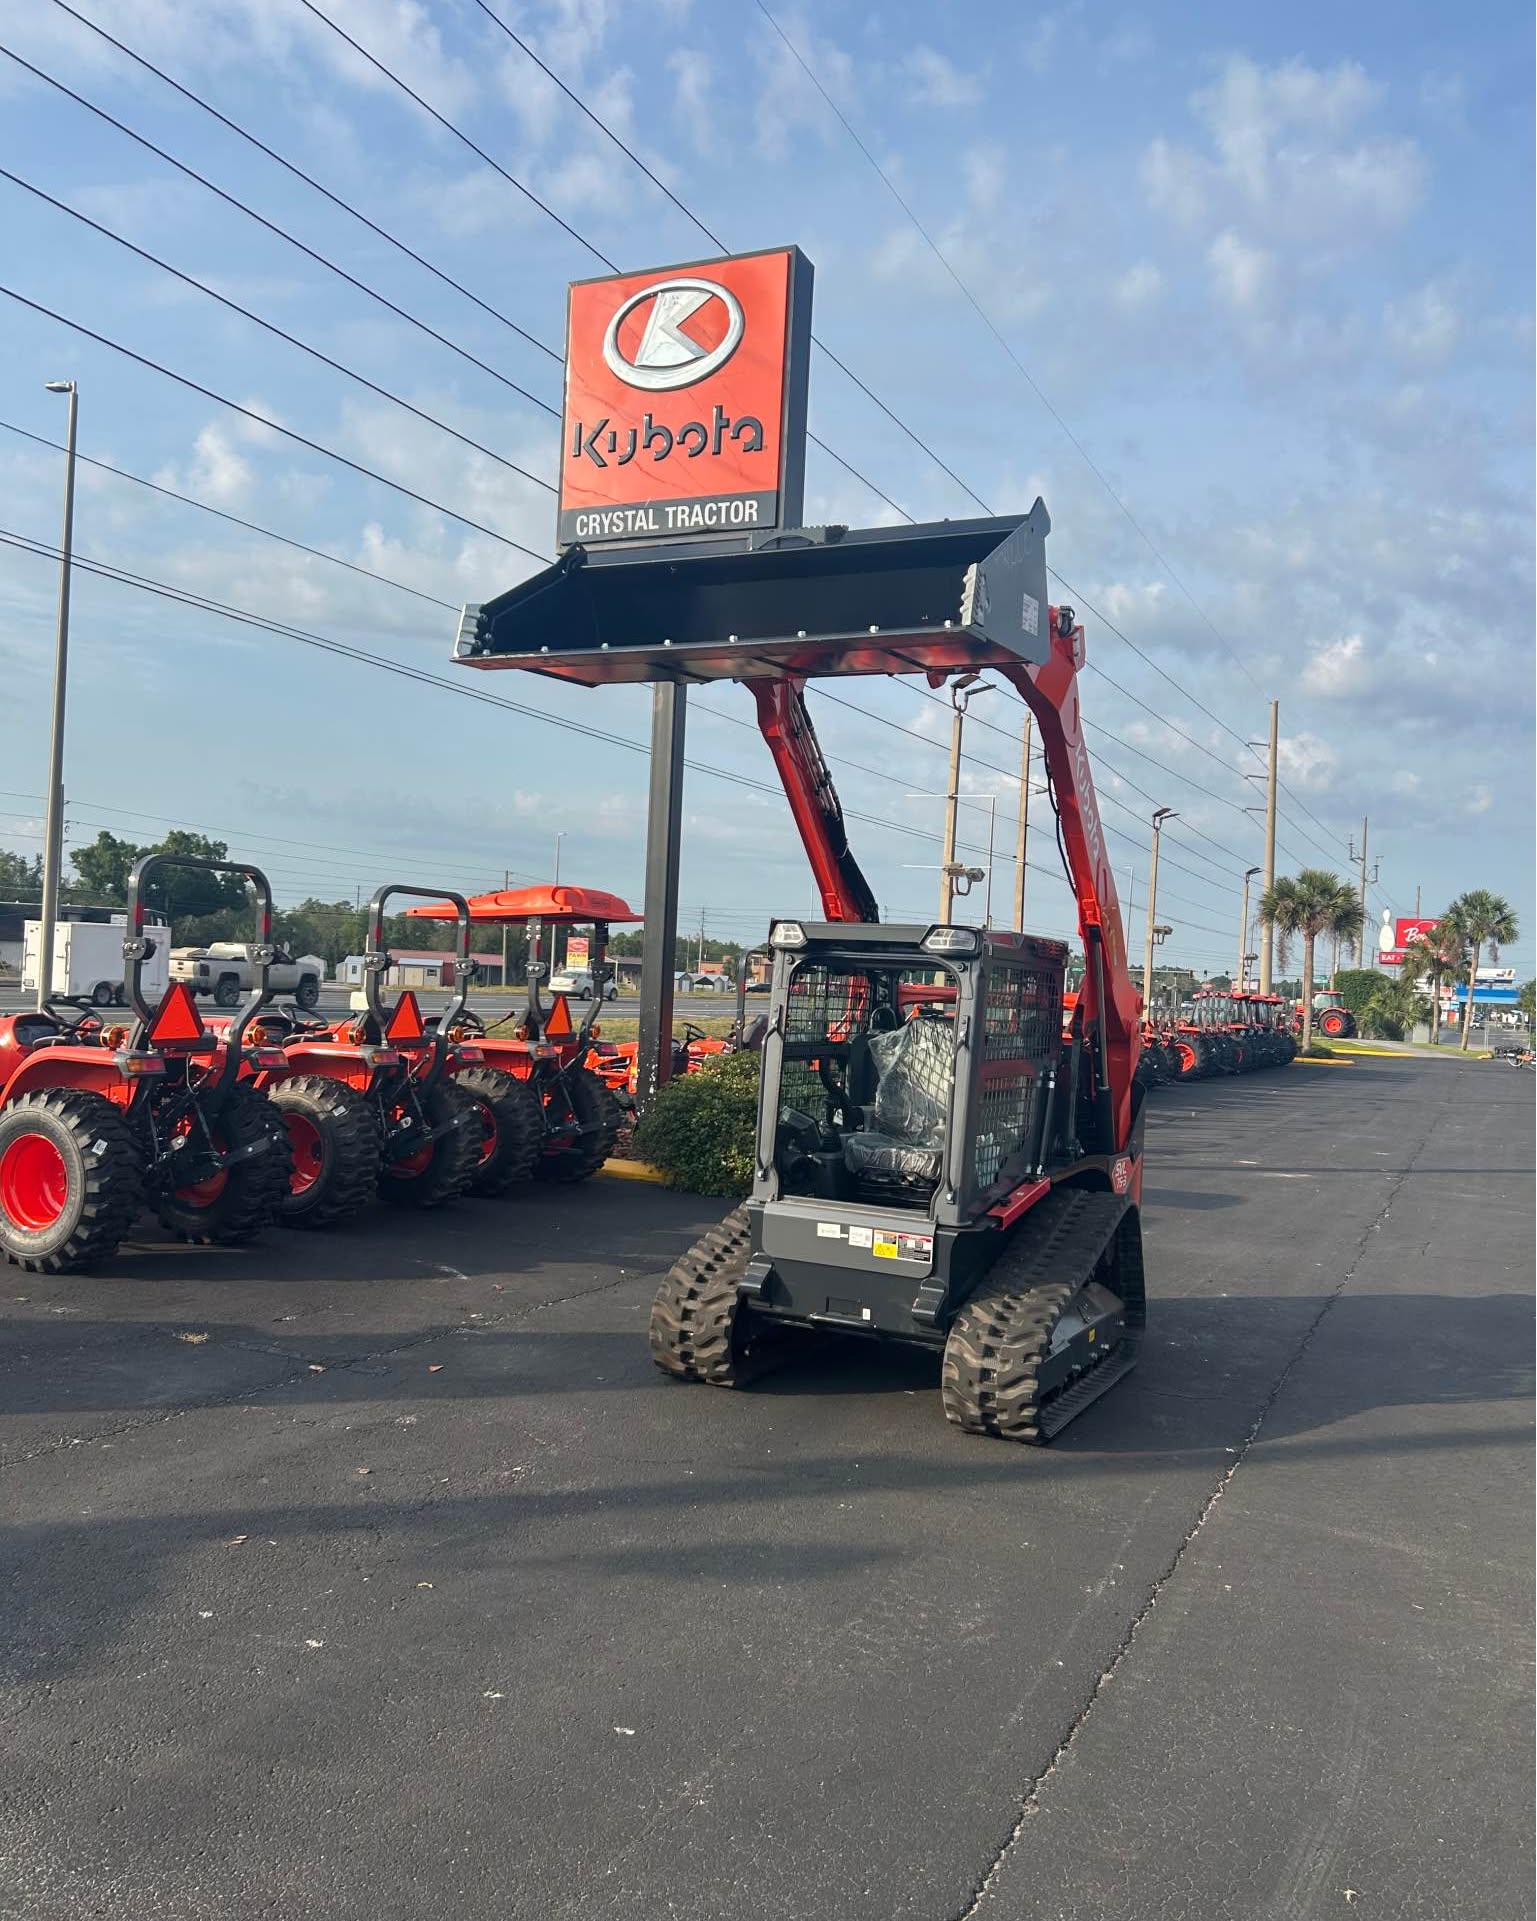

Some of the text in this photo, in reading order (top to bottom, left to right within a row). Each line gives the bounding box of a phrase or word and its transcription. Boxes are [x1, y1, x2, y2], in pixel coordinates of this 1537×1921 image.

[572, 405, 764, 468] Kubota
[576, 499, 758, 537] CRYSTAL TRACTOR
[1075, 740, 1100, 860] Kubota
[1381, 954, 1396, 962] EAT
